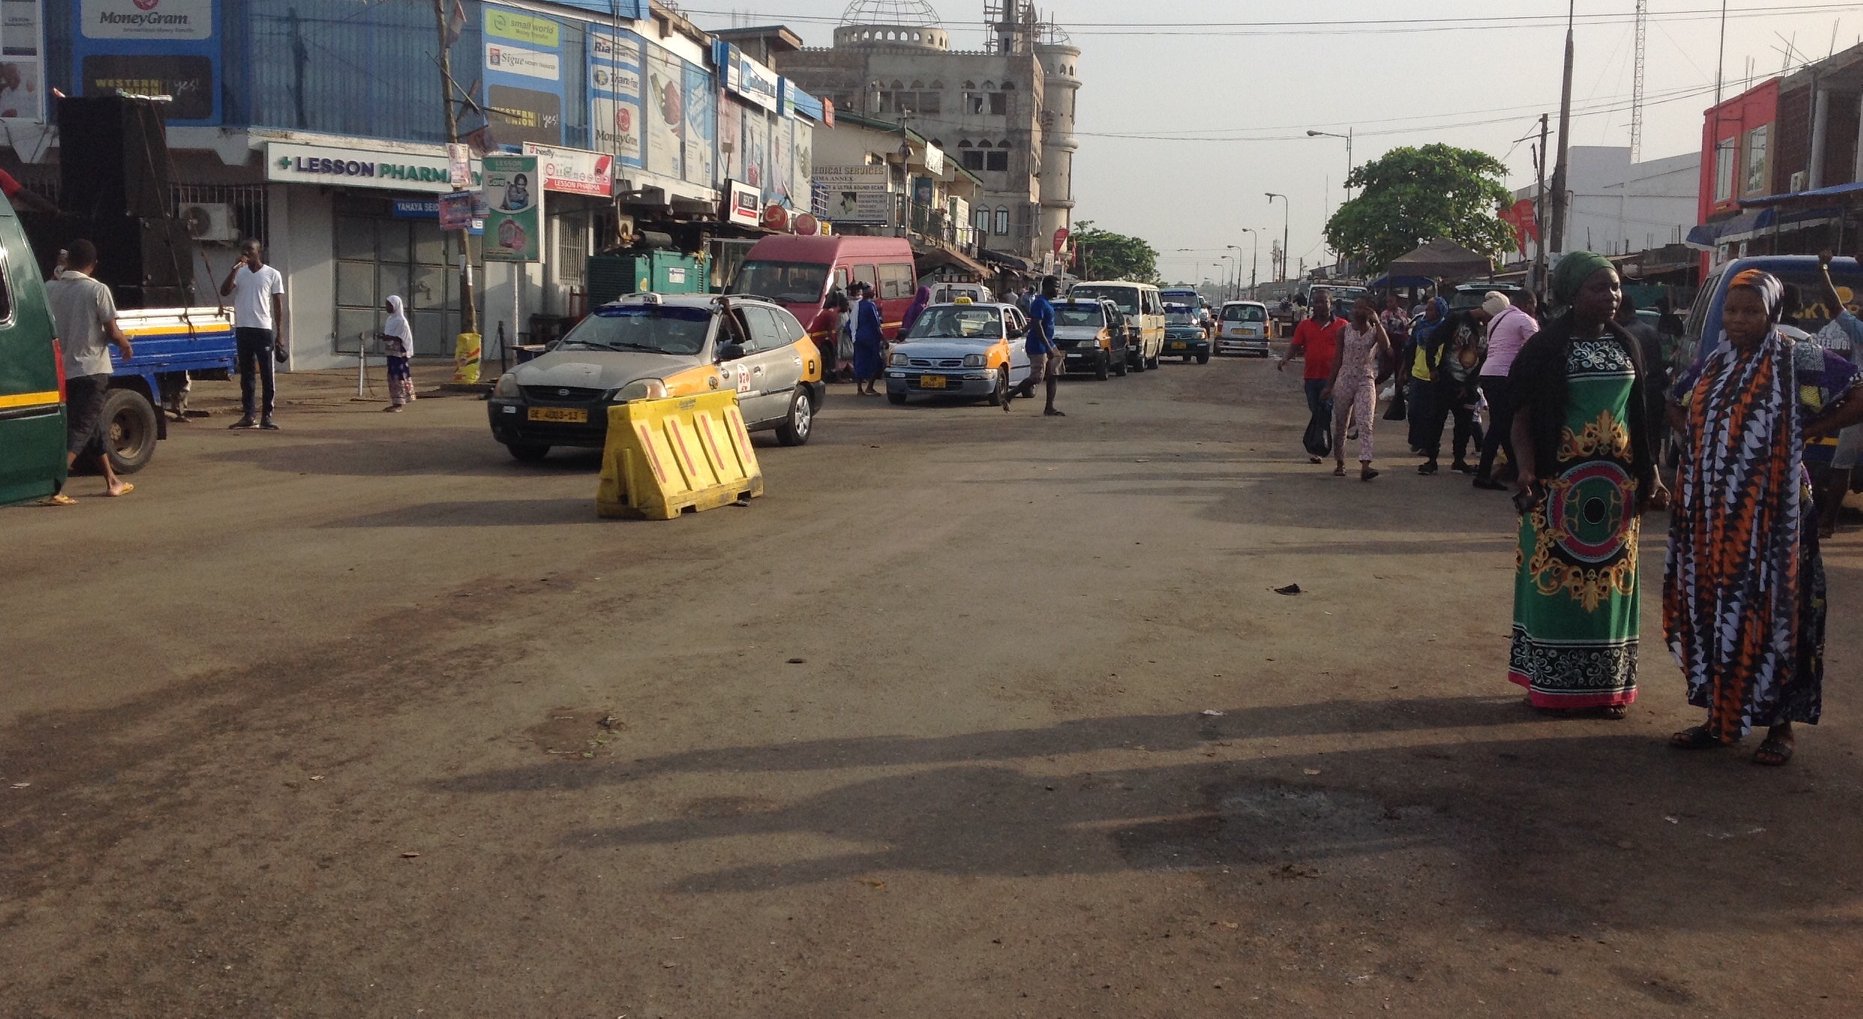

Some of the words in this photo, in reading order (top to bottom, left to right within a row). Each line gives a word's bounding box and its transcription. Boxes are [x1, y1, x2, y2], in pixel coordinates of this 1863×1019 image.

[100, 12, 188, 26] MoneyGram
[510, 20, 531, 29] small
[532, 24, 553, 34] world
[96, 79, 160, 88] WESTERN
[296, 157, 374, 177] LESSON
[845, 166, 883, 175] SERVICES
